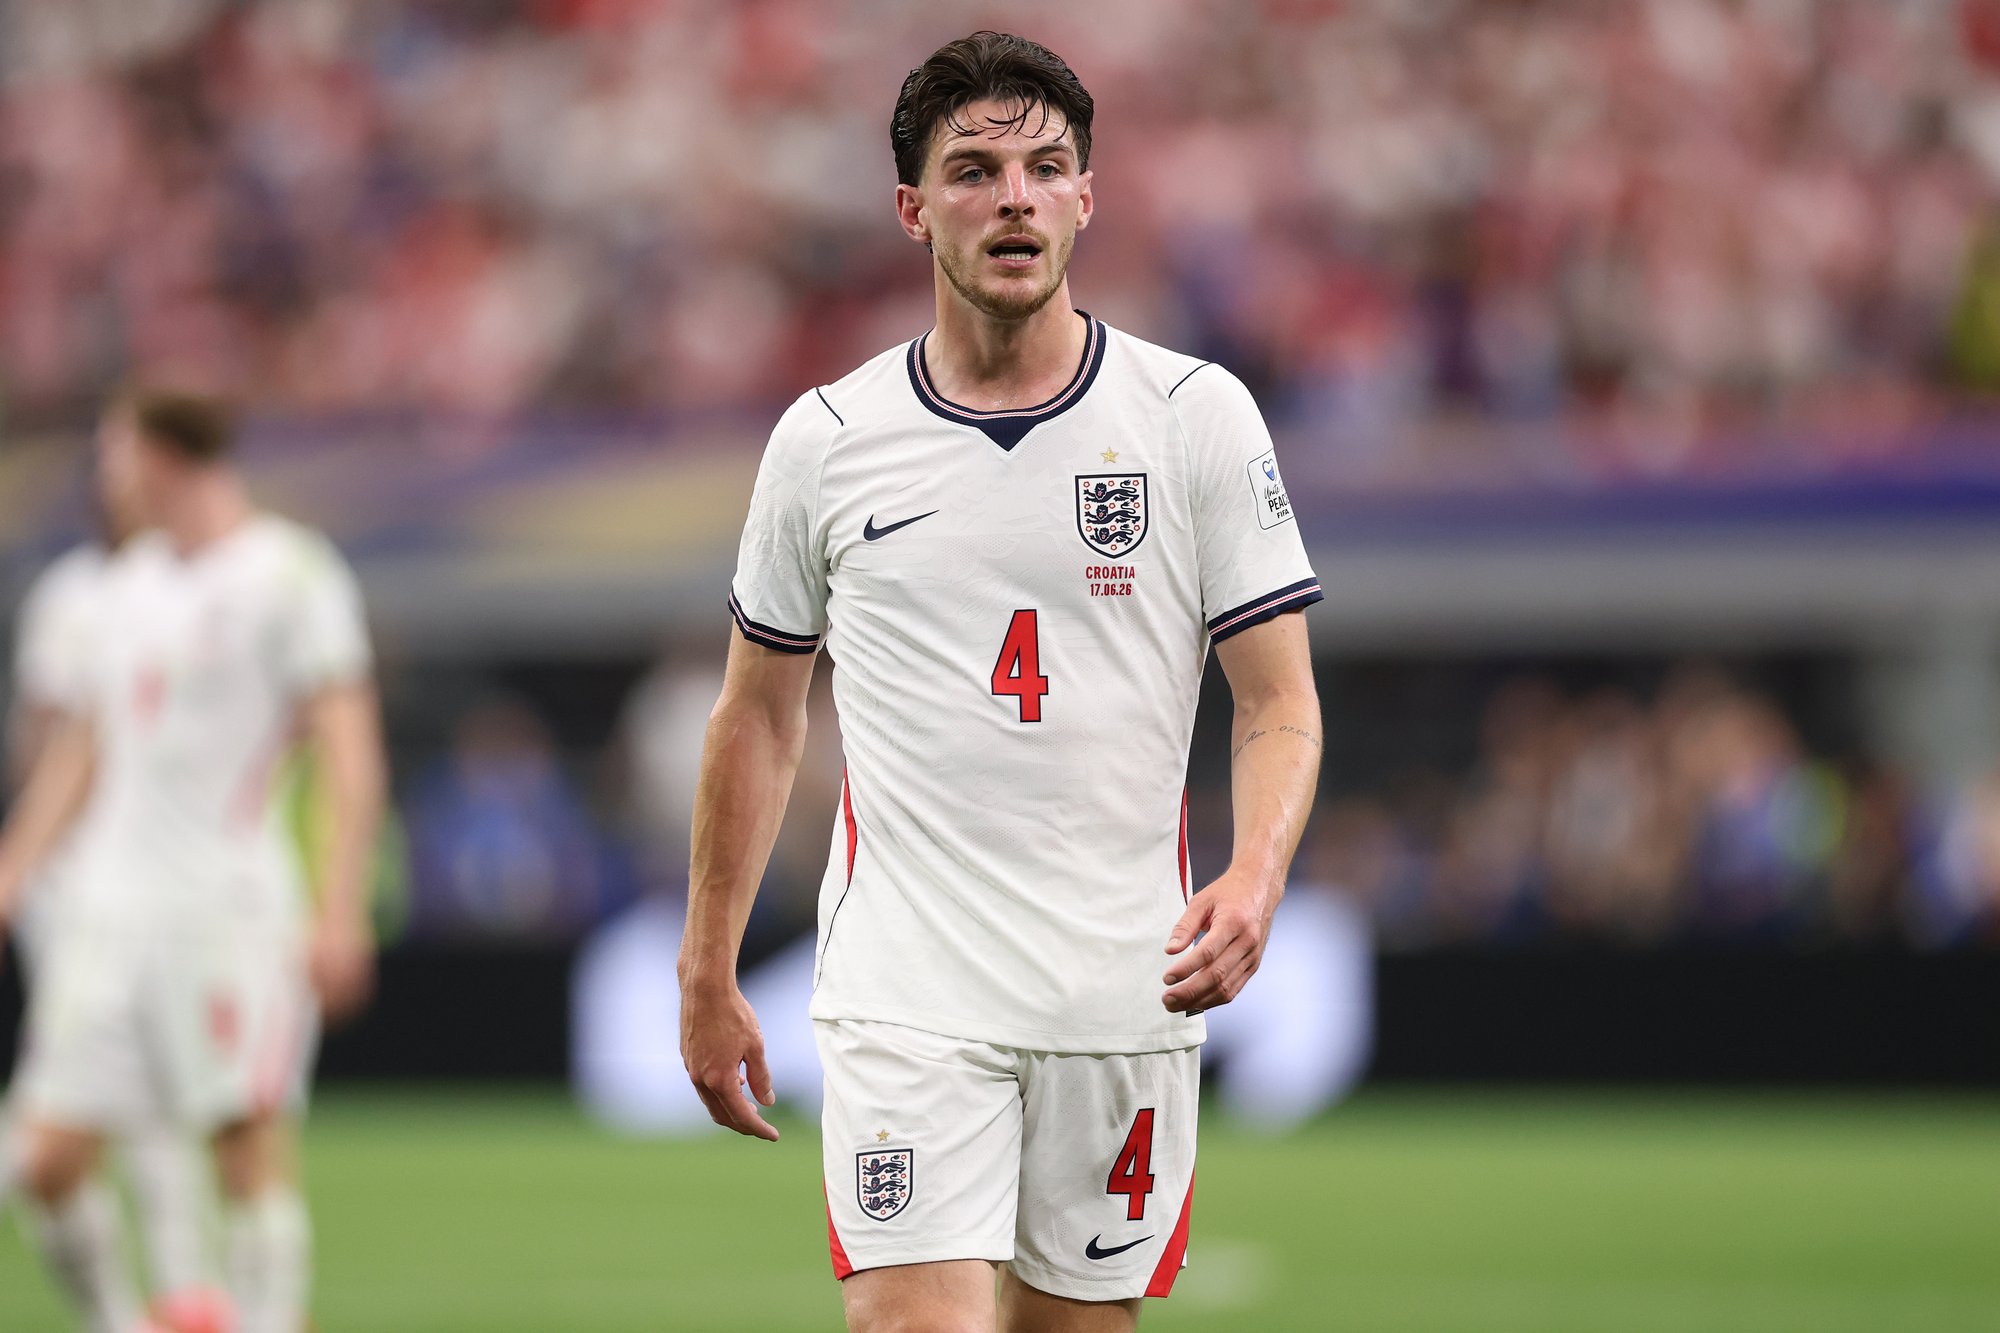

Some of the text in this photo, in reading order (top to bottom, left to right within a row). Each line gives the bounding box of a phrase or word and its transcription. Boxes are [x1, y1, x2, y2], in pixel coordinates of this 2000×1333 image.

[1276, 508, 1290, 519] FIFA
[1085, 566, 1135, 579] CROATIA
[1090, 583, 1132, 597] 17.06.26
[991, 609, 1048, 722] 4
[1106, 1108, 1155, 1221] 4
